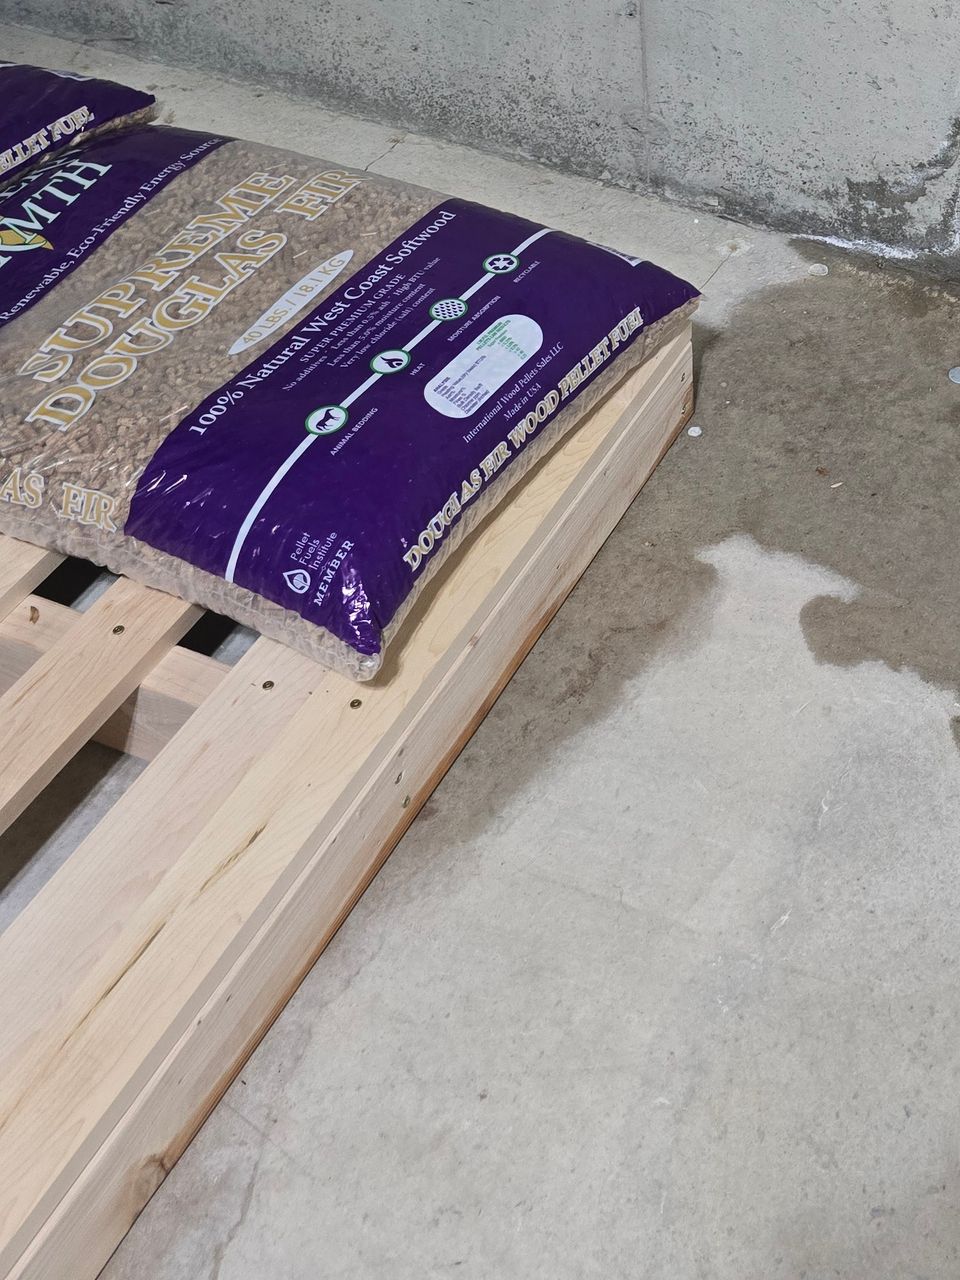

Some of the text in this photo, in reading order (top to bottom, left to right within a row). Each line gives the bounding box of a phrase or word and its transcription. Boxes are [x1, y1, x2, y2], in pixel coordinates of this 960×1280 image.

[0, 258, 75, 321] Renewable,
[66, 188, 146, 258] Eco-Friendly
[140, 159, 187, 193] Energy
[179, 137, 224, 163] Source
[18, 170, 298, 384] SUPREME
[24, 168, 367, 433] DOUGLAS FIR
[241, 330, 262, 346] 40
[322, 256, 346, 276] KG
[188, 210, 457, 436] 100% Natural West Coast Softwood
[295, 354, 329, 383] additives
[346, 322, 365, 338] than
[299, 272, 407, 364] SUPER PREMIUM GRADE
[326, 350, 345, 367] Less
[342, 338, 362, 353] than
[374, 302, 404, 327] moisture
[402, 282, 427, 304] content
[339, 352, 358, 369] Very
[354, 342, 372, 357] low
[369, 321, 398, 345] chloride
[411, 287, 437, 308] content
[446, 318, 475, 343] MOISTURE
[409, 361, 427, 377] HEAT
[462, 400, 503, 445] International
[500, 383, 521, 405] Wood
[518, 367, 539, 388] Pellets
[536, 355, 553, 371] Sales
[549, 341, 564, 357] LLC
[503, 400, 523, 421] Made
[526, 382, 543, 399] USA
[329, 406, 379, 457] ANIMAL BEDDING
[479, 440, 512, 482] FIR
[507, 389, 561, 450] WOOD
[558, 336, 611, 401] PELLET
[58, 481, 118, 533] FIR
[289, 531, 312, 562] Pellet
[298, 538, 321, 567] Fuels
[307, 531, 338, 572] Institute
[312, 539, 355, 608] MEMBER
